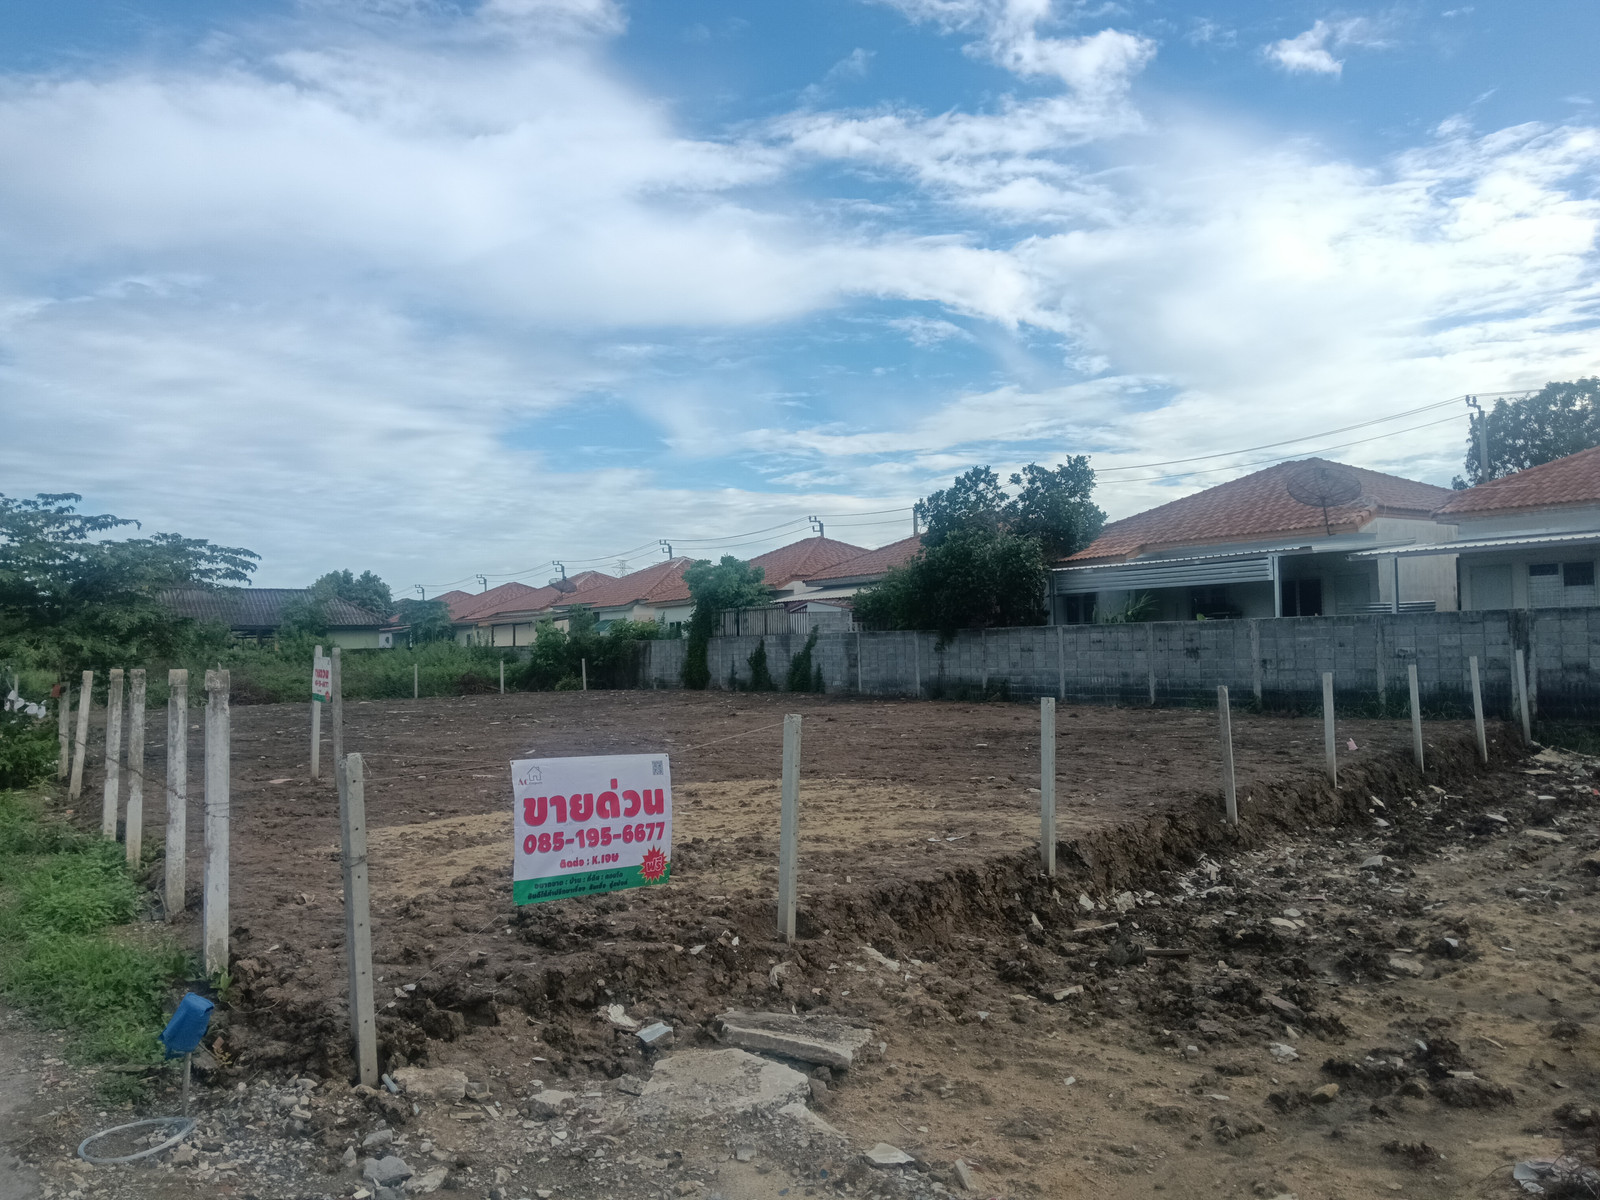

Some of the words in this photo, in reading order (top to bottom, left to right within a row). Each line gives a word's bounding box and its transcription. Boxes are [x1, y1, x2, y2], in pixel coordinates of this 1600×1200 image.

[523, 778, 664, 826] ขายด่วน
[523, 822, 665, 855] 085-195-6677
[560, 857, 584, 868] ติดต่อ
[646, 856, 662, 872] ฟรี
